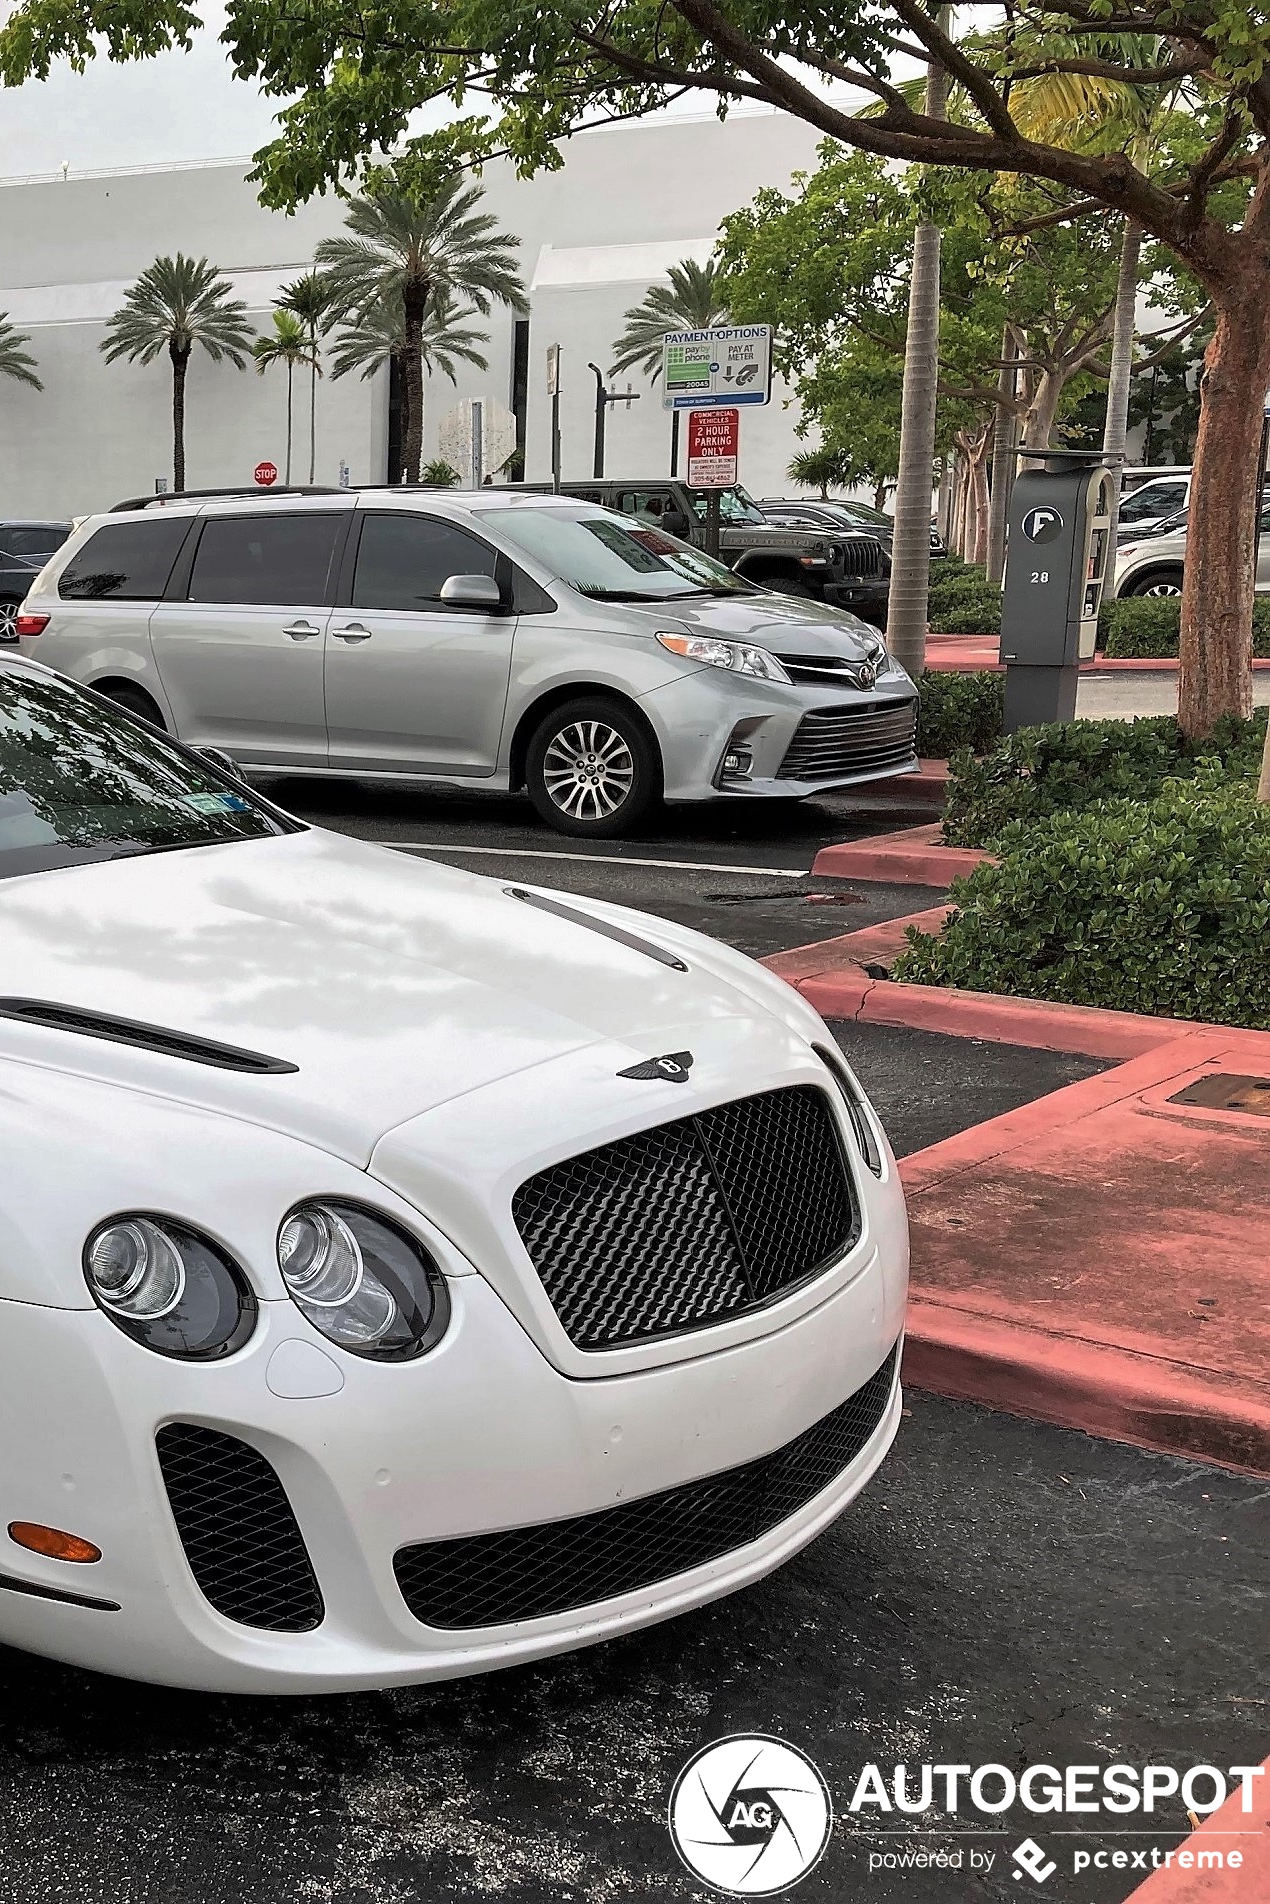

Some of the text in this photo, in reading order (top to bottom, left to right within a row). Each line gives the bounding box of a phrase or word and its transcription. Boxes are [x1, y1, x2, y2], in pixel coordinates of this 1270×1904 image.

[665, 327, 767, 343] PAYMENT OPTIONS
[685, 346, 701, 354] pay
[728, 344, 754, 353] PAY AT
[685, 353, 710, 363] phone
[728, 353, 754, 361] METER
[697, 426, 730, 436] 2 HOUR
[695, 436, 732, 446] PARKING
[702, 447, 724, 456] ONLY
[255, 469, 276, 479] STOP
[1030, 572, 1049, 583] 28
